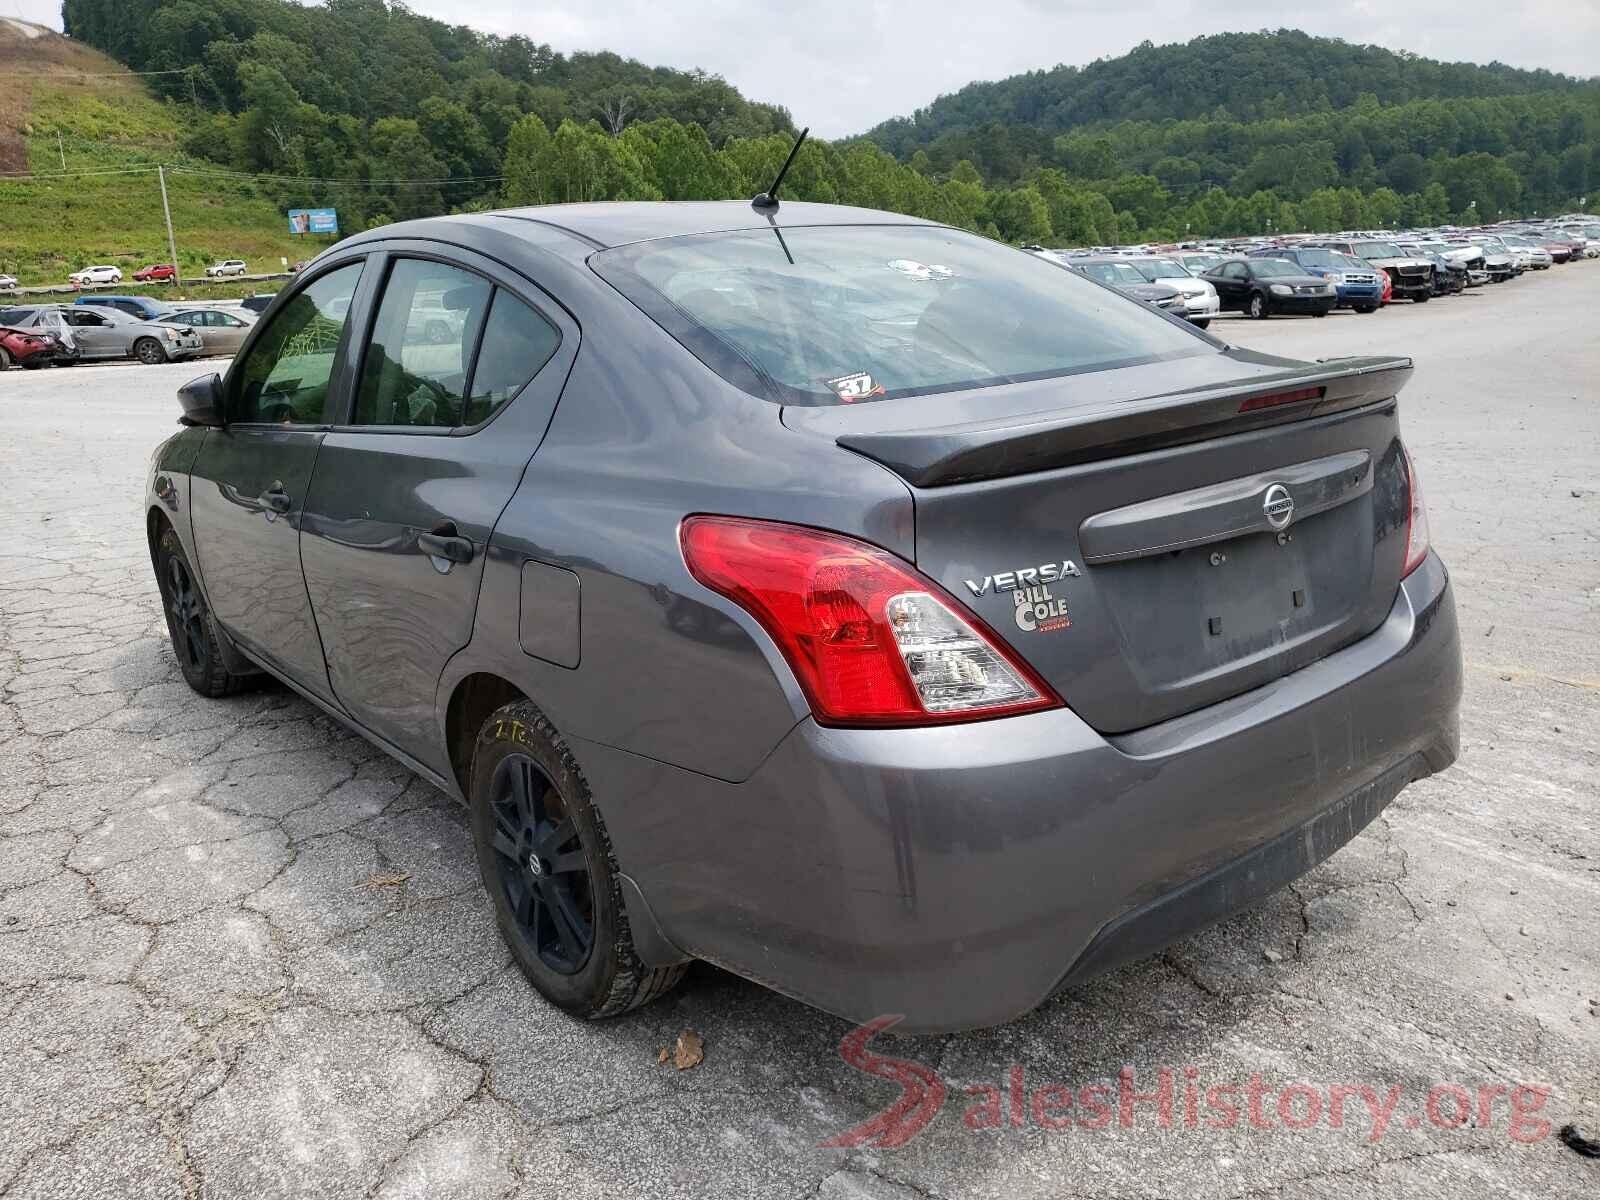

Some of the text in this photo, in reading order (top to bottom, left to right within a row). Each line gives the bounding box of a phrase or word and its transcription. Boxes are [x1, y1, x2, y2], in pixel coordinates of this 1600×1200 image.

[837, 374, 872, 397] 37
[962, 560, 1081, 597] VERSA
[1012, 584, 1053, 607] BILL
[1015, 599, 1068, 632] COLE
